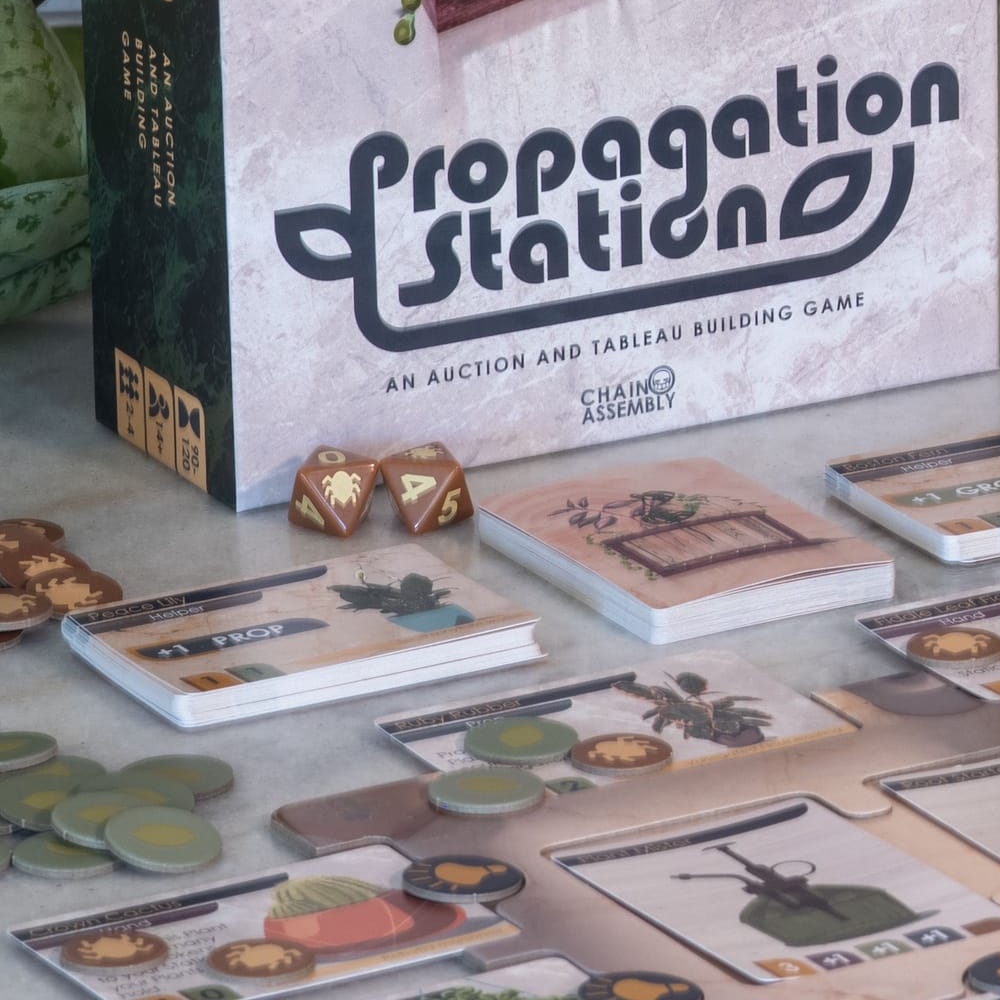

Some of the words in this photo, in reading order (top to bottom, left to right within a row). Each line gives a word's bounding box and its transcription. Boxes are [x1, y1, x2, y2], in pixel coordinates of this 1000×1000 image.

[121, 30, 132, 101] GAME
[149, 44, 159, 96] AND
[163, 51, 172, 87] AN
[134, 37, 147, 150] BUILDING
[164, 96, 177, 207] AUCTION
[349, 54, 961, 219] Propagation
[151, 106, 163, 209] TABLEAU
[398, 178, 768, 308] Station
[386, 372, 416, 394] AN
[427, 353, 526, 387] AUCTION
[537, 343, 582, 367] AND
[592, 325, 683, 356] TABLEAU
[693, 304, 793, 337] BUILDING
[803, 291, 866, 317] GAME
[580, 378, 648, 408] CHAIN
[581, 392, 677, 426] ASSEMBLY
[843, 456, 904, 473] Boston
[900, 457, 954, 474] Helper
[911, 492, 942, 505] +1
[87, 600, 155, 622] Peace
[149, 604, 205, 622] Helper
[939, 610, 987, 627] Hand
[157, 643, 190, 658] +1
[211, 623, 284, 648] PROP
[393, 714, 447, 732] Ruby
[448, 699, 522, 719] Rubber
[105, 899, 183, 923] Cactus
